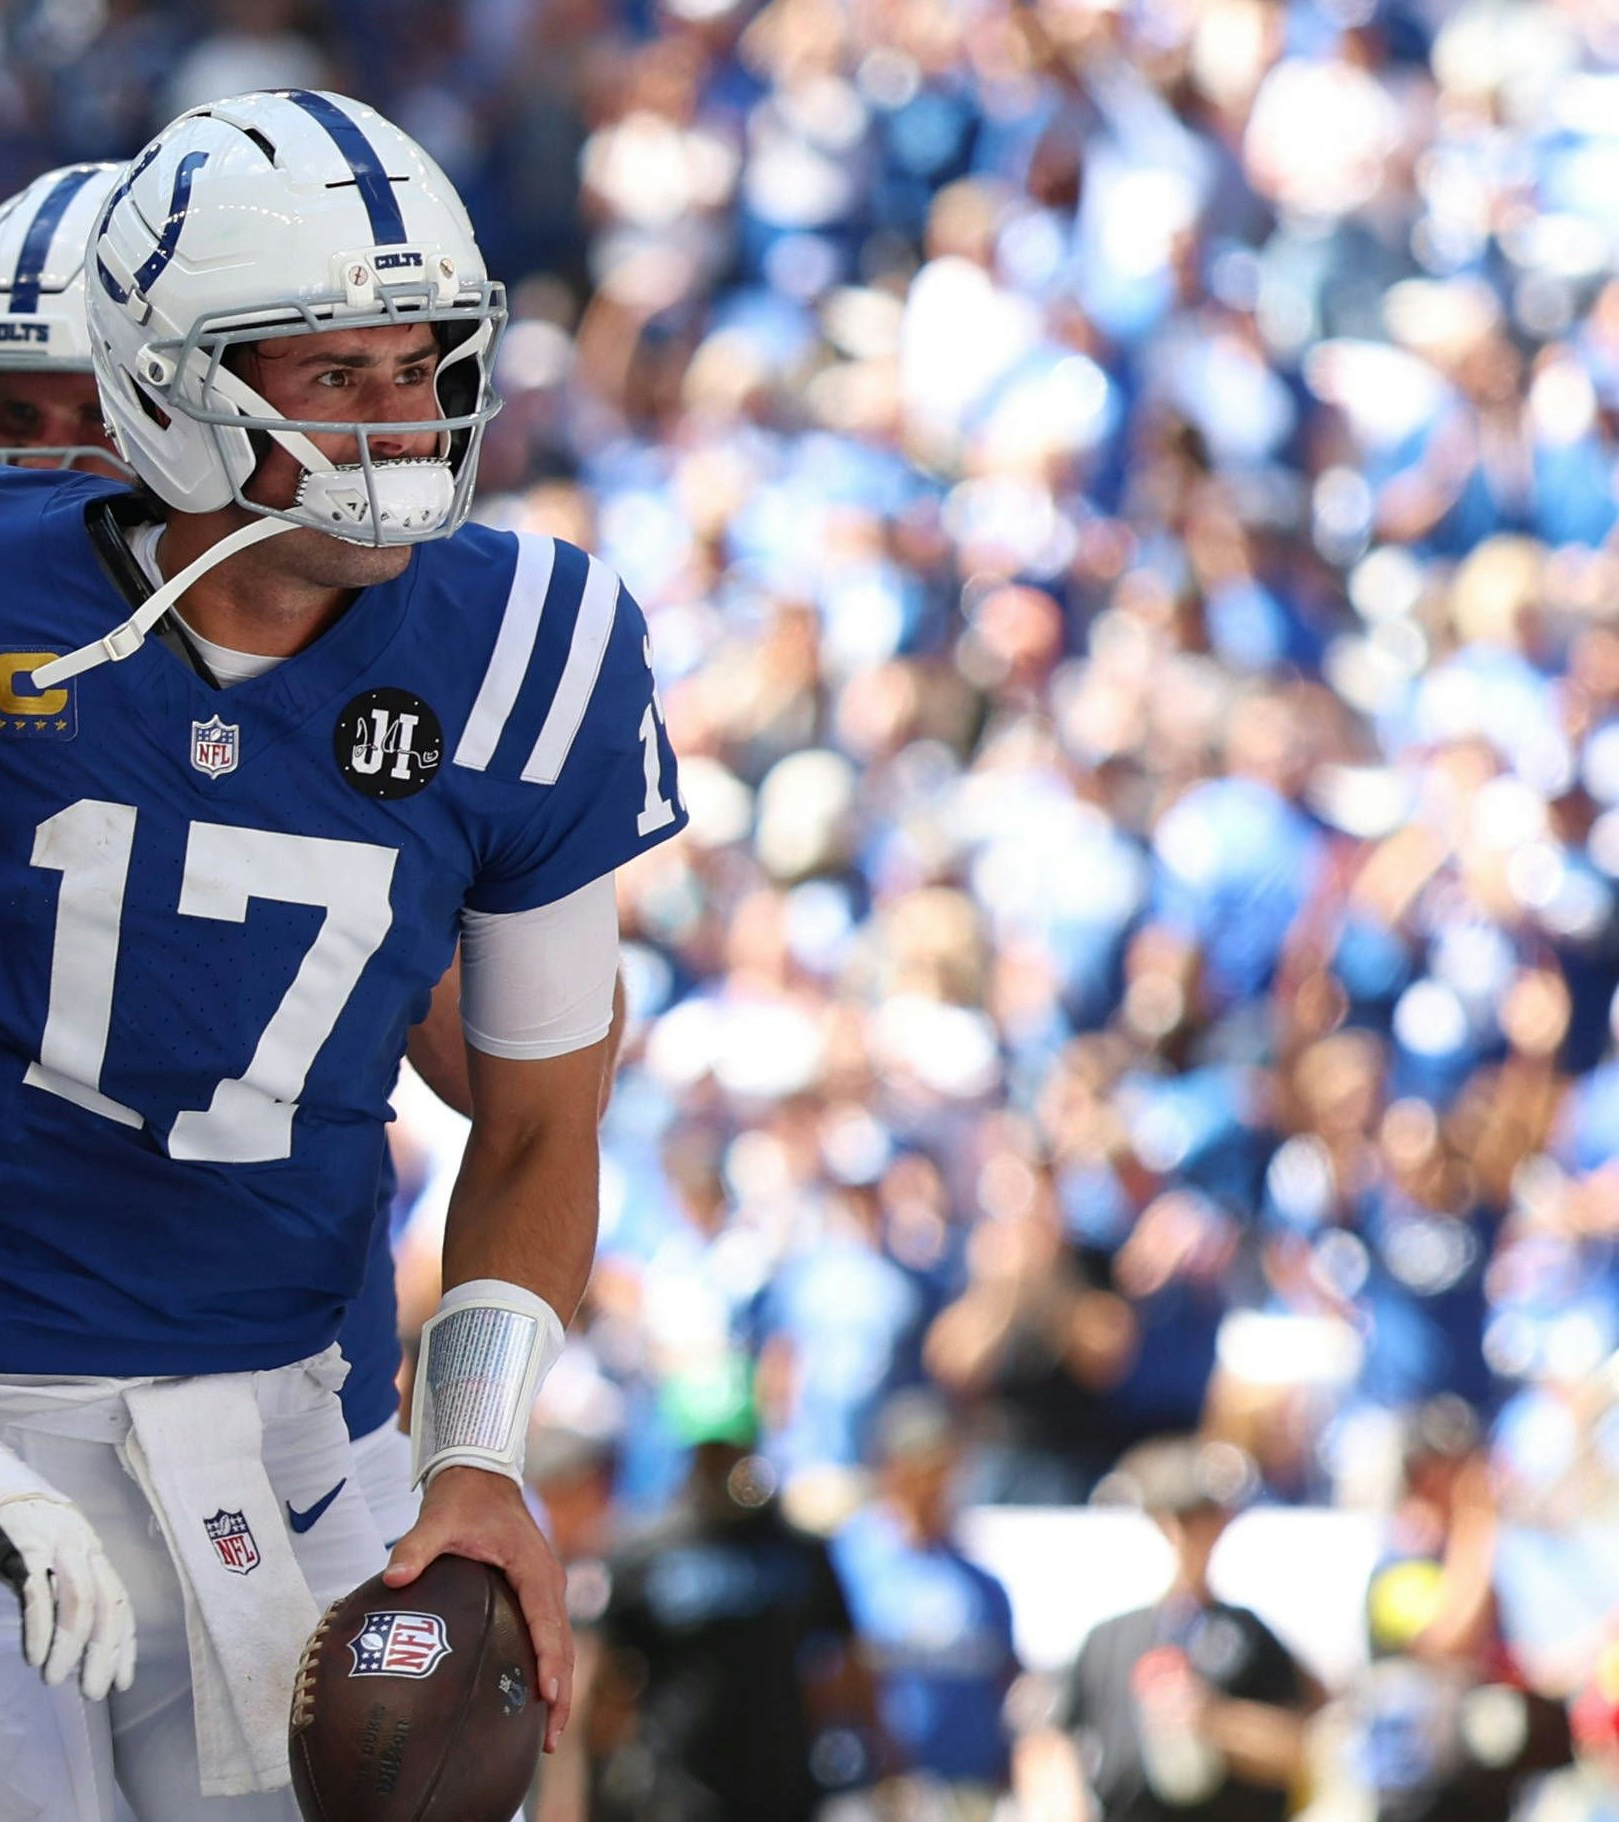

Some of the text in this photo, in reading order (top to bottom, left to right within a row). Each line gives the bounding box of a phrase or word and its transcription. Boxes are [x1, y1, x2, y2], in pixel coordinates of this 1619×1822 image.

[374, 252, 423, 270] COLTS
[199, 743, 231, 768] NFL
[22, 798, 399, 1165] 17
[215, 1534, 256, 1568] NFL
[385, 1619, 436, 1671] NFL
